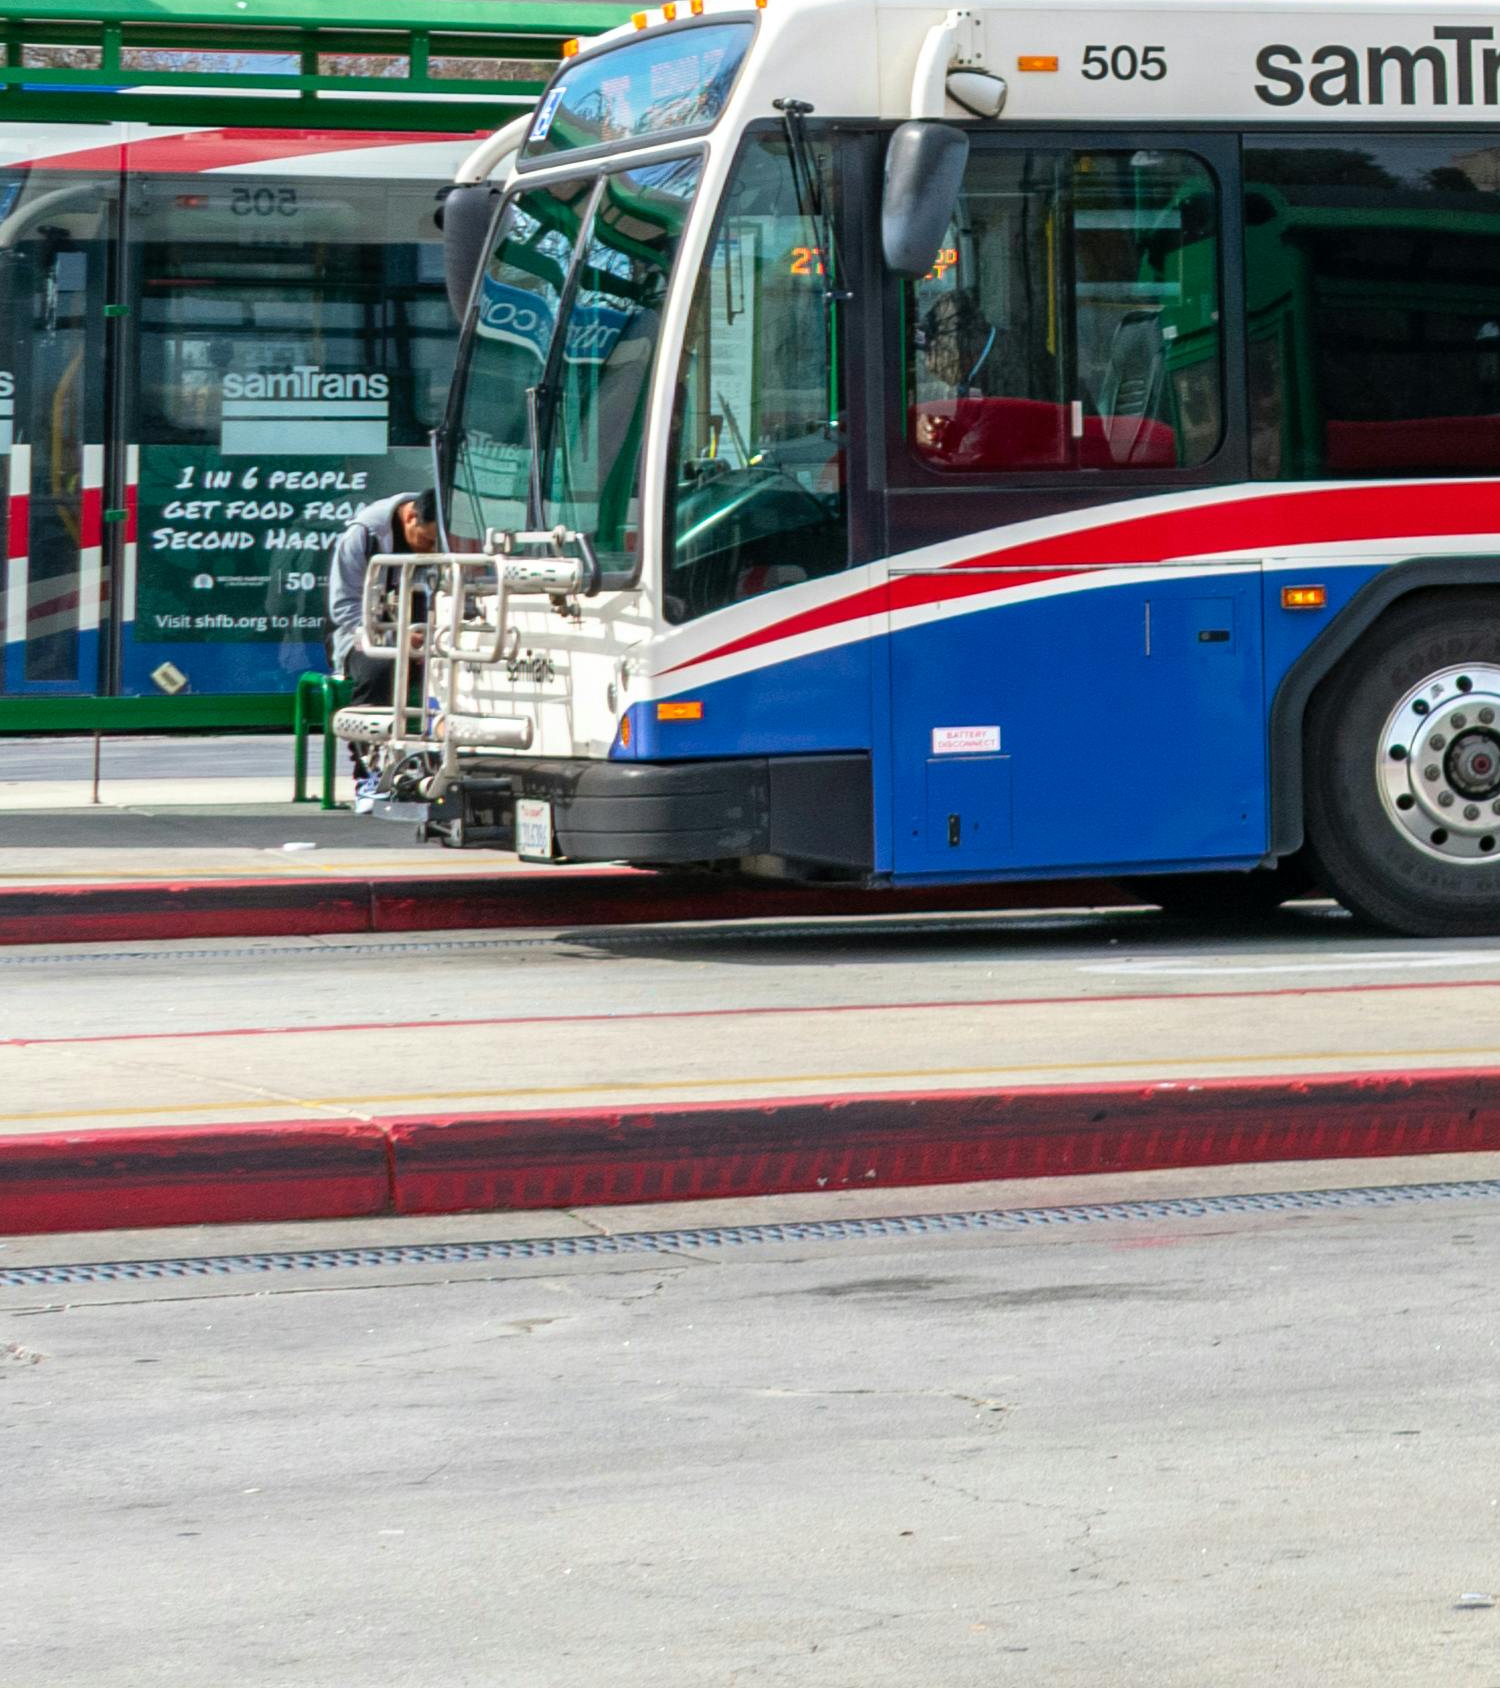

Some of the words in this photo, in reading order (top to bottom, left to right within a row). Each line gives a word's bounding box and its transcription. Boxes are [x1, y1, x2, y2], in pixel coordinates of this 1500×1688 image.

[1080, 45, 1168, 81] 505
[222, 365, 389, 399] samTrans
[175, 466, 195, 489] 1
[205, 470, 233, 489] IN
[242, 466, 259, 490] 6
[268, 471, 368, 490] PEOPLE
[163, 501, 221, 520] GET
[225, 501, 294, 520] FOOD
[285, 572, 316, 591] 50
[155, 614, 191, 629] Visit
[194, 614, 268, 632] shfb.org
[271, 615, 290, 629] to
[293, 614, 326, 629] lear
